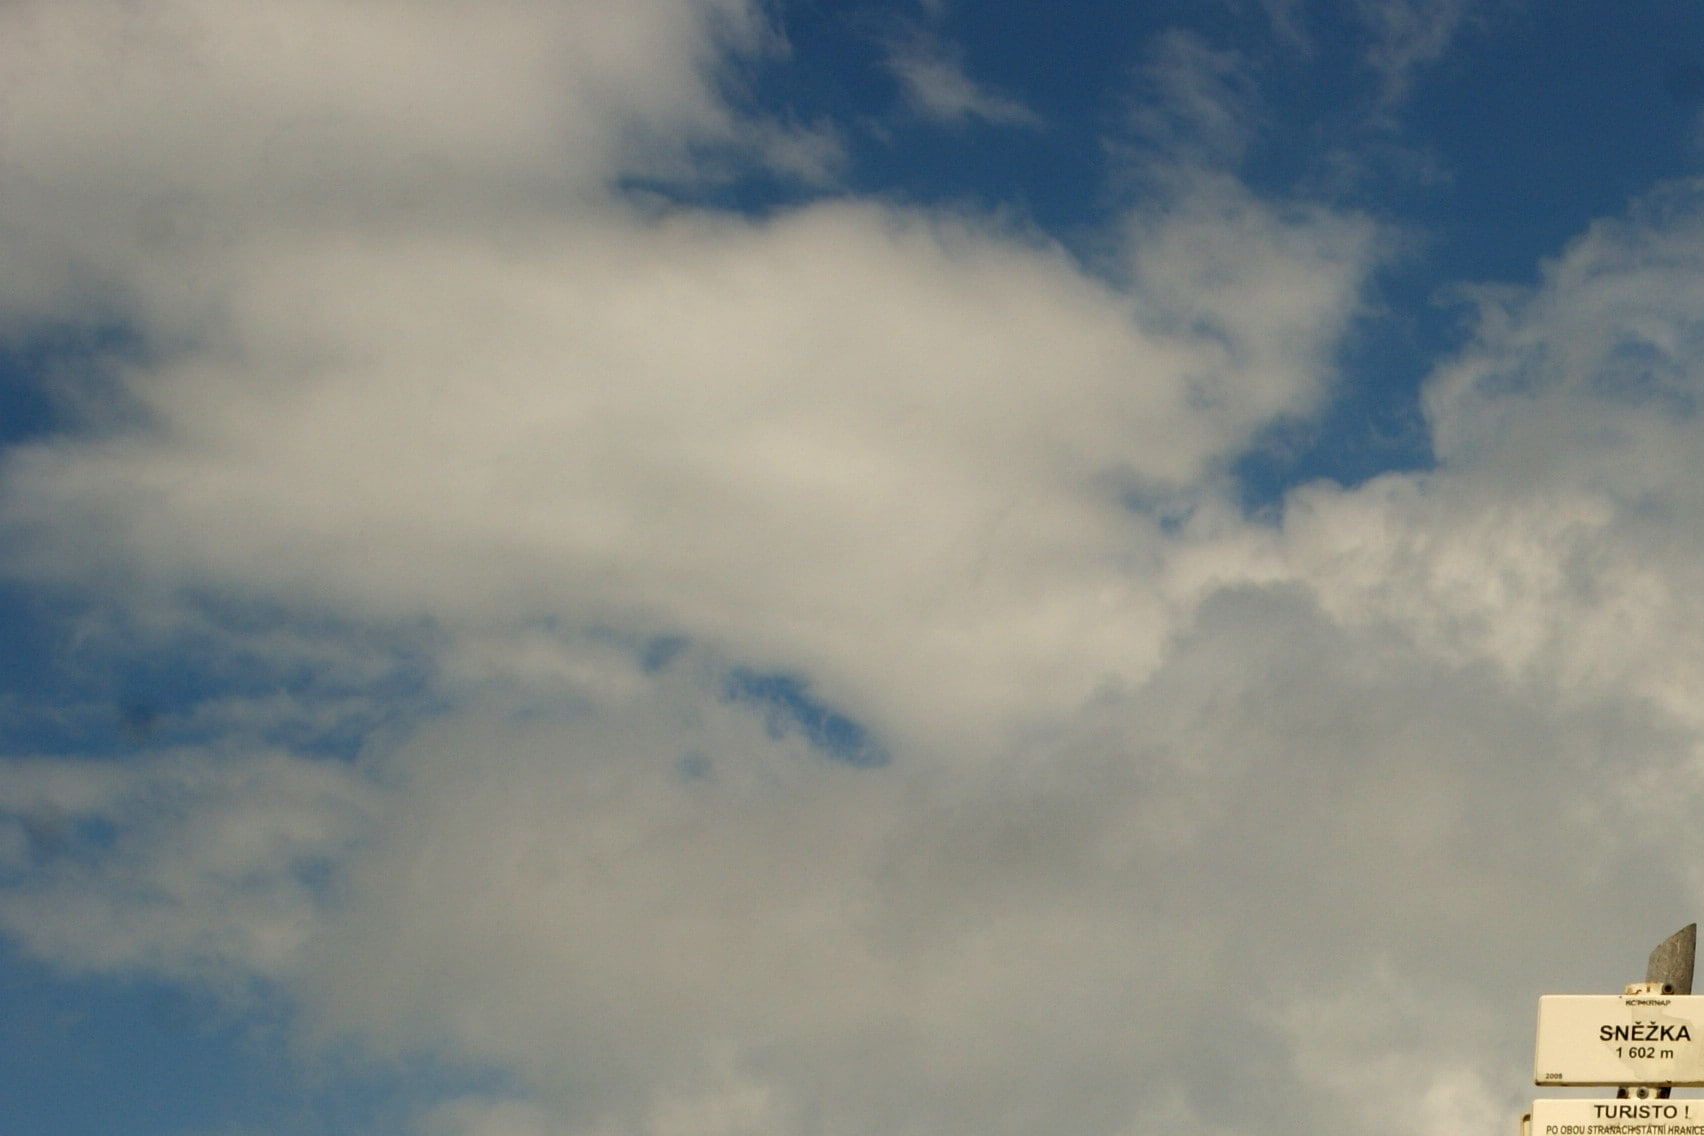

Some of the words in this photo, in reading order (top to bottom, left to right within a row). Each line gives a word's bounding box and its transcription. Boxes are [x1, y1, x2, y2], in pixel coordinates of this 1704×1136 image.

[1599, 1021, 1691, 1042] SNĚŽKA
[1616, 1047, 1622, 1058] 1
[1629, 1047, 1655, 1058] 602
[1660, 1050, 1674, 1058] m
[1594, 1105, 1677, 1119] TURISTO
[1546, 1125, 1558, 1135] PO
[1560, 1125, 1585, 1135] OBOU
[1668, 1125, 1704, 1136] HRANICE
